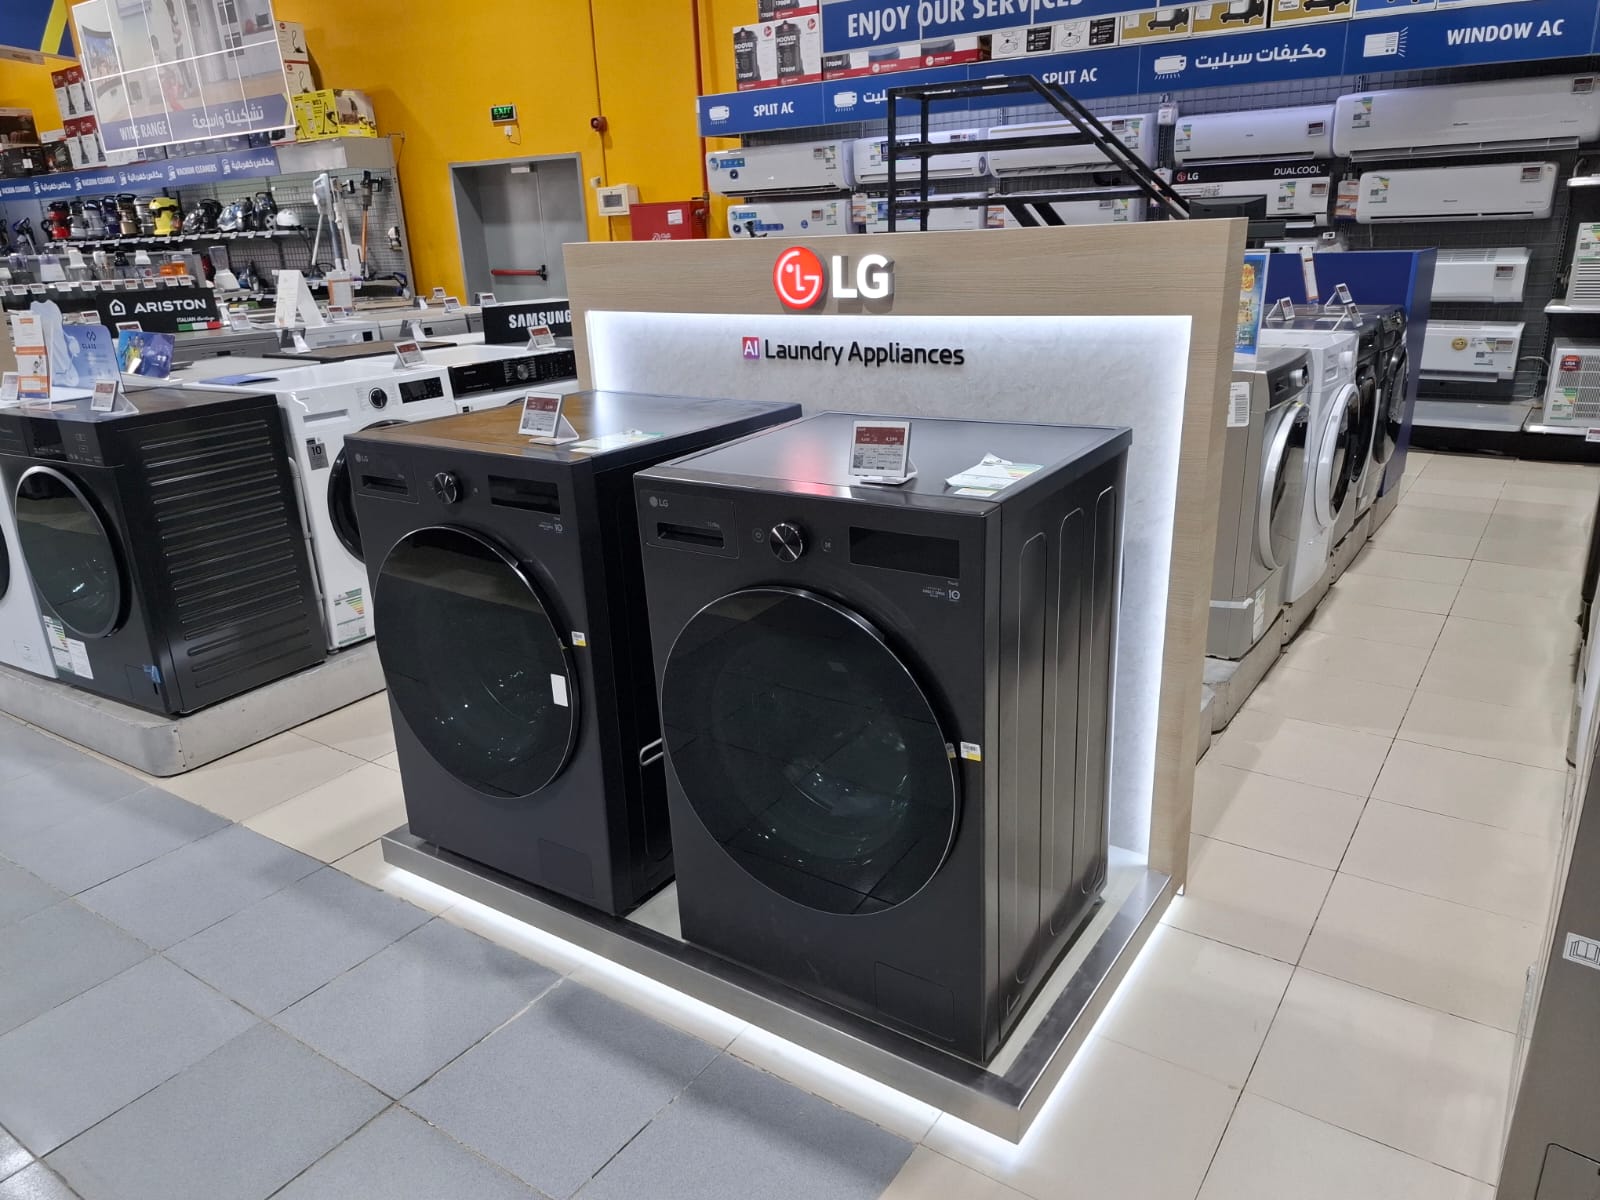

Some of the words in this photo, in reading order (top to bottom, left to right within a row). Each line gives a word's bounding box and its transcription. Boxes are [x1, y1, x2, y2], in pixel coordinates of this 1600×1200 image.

[848, 6, 909, 41] ENJOY
[918, 0, 965, 27] OUR
[972, 0, 1083, 18] SERV
[1447, 22, 1533, 45] WINDOW
[1537, 19, 1565, 38] AC
[1195, 51, 1253, 70] سبليت
[1256, 43, 1327, 62] مكيفات
[1042, 70, 1076, 86] SPLIT
[1078, 67, 1098, 83] AC
[225, 104, 264, 125] تشكيلة
[494, 107, 511, 115] EXIT
[753, 103, 778, 118] SPLIT
[780, 101, 795, 116] AC
[192, 113, 225, 129] واسعة
[119, 126, 141, 141] WIDE
[140, 121, 168, 138] RANGE
[1187, 172, 1199, 181] LG
[1273, 165, 1321, 176] DUALCOOL
[832, 254, 889, 299] LG
[134, 299, 207, 314] ARISTON
[508, 309, 571, 330] SAMSUNG
[743, 340, 758, 356] AI
[765, 339, 844, 366] Laundry
[848, 341, 965, 368] Appliances
[311, 445, 322, 456] 10
[658, 498, 669, 508] LG
[948, 589, 961, 600] 10
